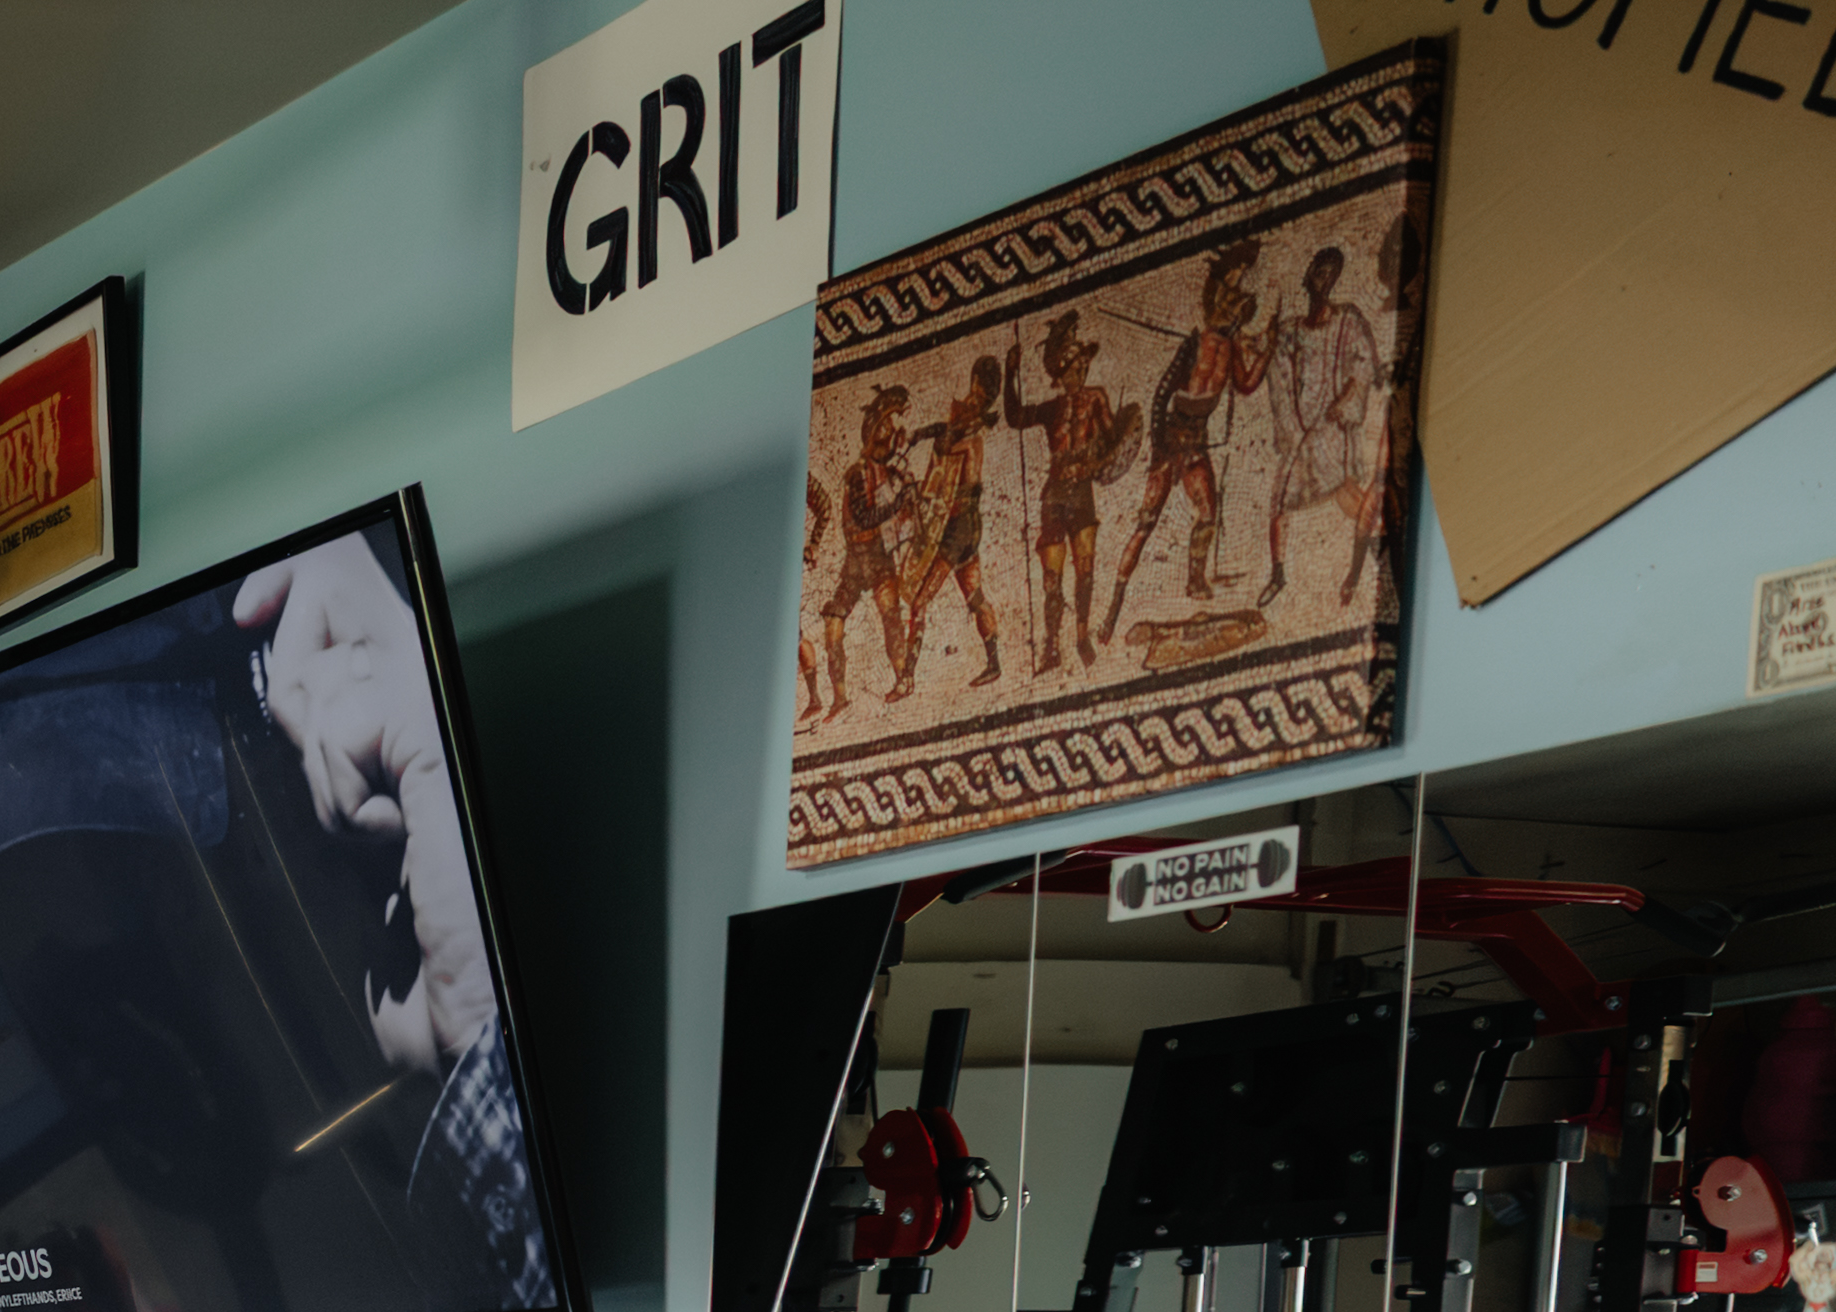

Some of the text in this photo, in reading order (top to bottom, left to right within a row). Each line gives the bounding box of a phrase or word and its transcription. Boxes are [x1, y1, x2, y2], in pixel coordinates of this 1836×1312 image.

[546, 0, 826, 315] GRIT
[1157, 846, 1248, 880] NO PAIN
[1155, 870, 1247, 904] NO GAIN
